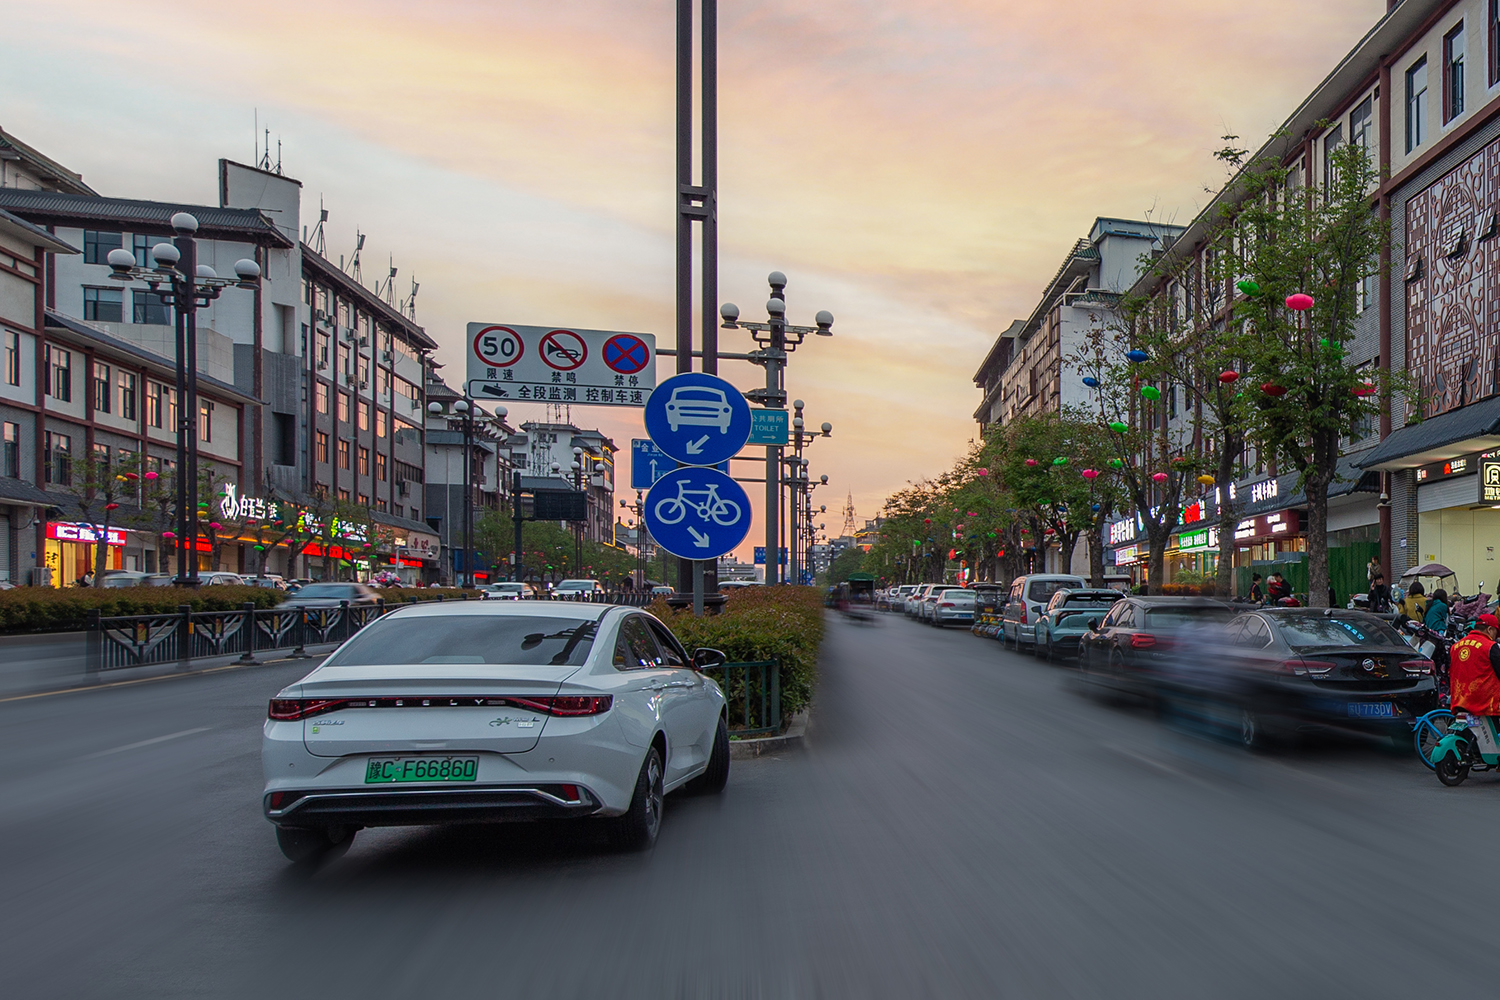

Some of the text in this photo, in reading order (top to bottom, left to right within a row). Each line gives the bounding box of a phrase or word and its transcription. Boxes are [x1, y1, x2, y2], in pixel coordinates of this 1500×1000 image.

[483, 336, 515, 357] 50
[486, 368, 514, 380] 限速
[551, 371, 577, 383] 禁鸣
[614, 374, 639, 387] 禁停
[518, 385, 643, 404] 全段监测 控制车速
[754, 424, 779, 432] TOILET
